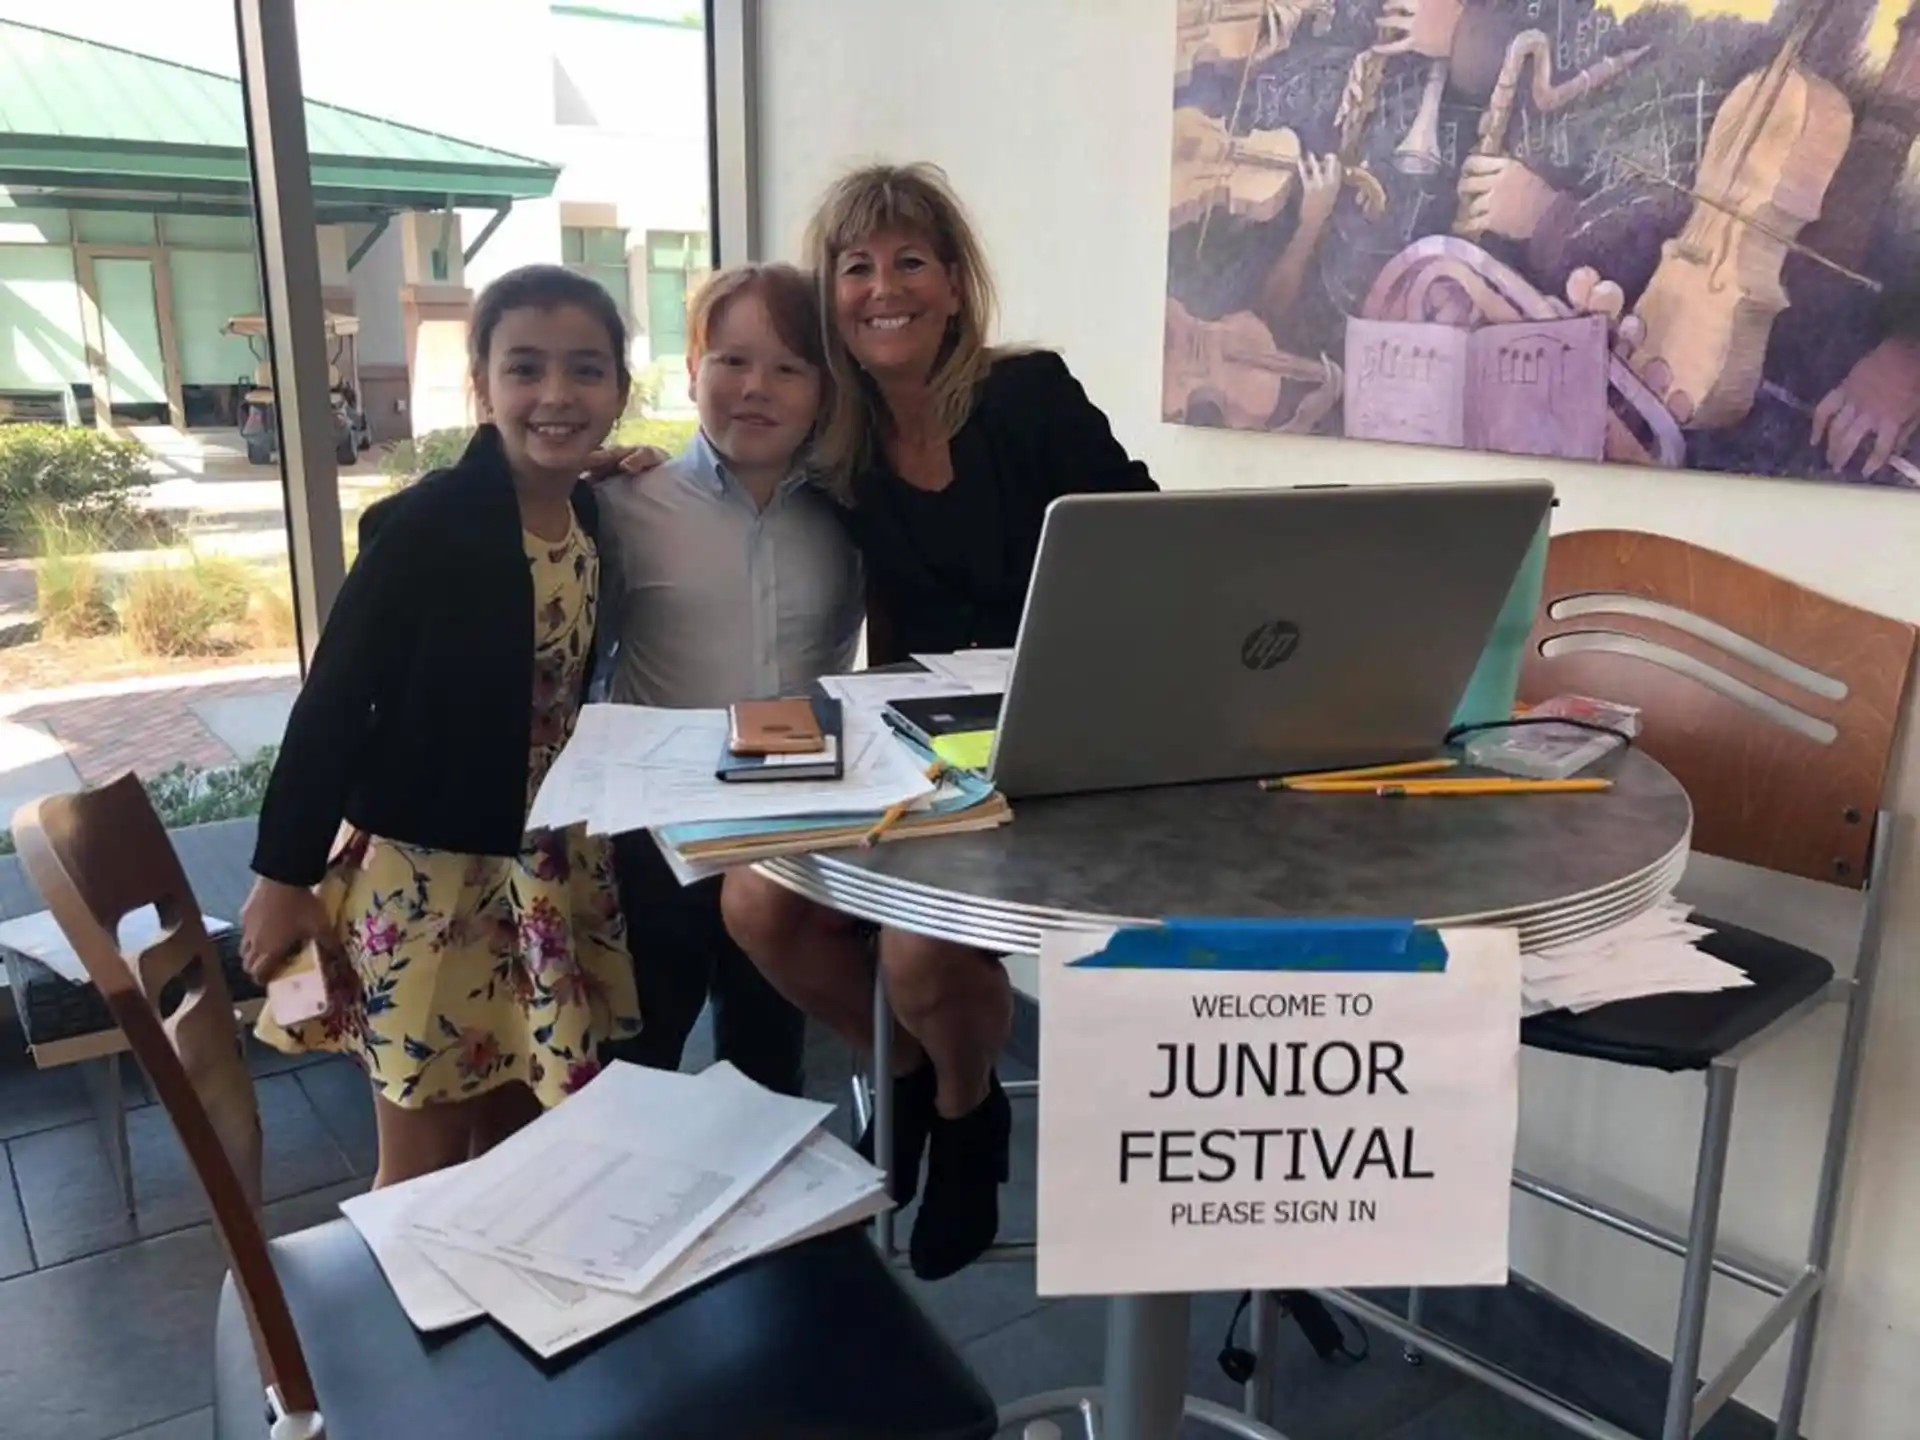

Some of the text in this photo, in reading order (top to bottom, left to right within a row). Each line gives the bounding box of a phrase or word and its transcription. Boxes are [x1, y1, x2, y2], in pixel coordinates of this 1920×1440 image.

[1242, 621, 1299, 670] hp
[1192, 993, 1373, 1019] WELCOME TO
[1148, 1040, 1410, 1099] JUNIOR
[1119, 1126, 1435, 1185] FESTIVAL
[1171, 1200, 1377, 1226] PLEASE SIGN IN
